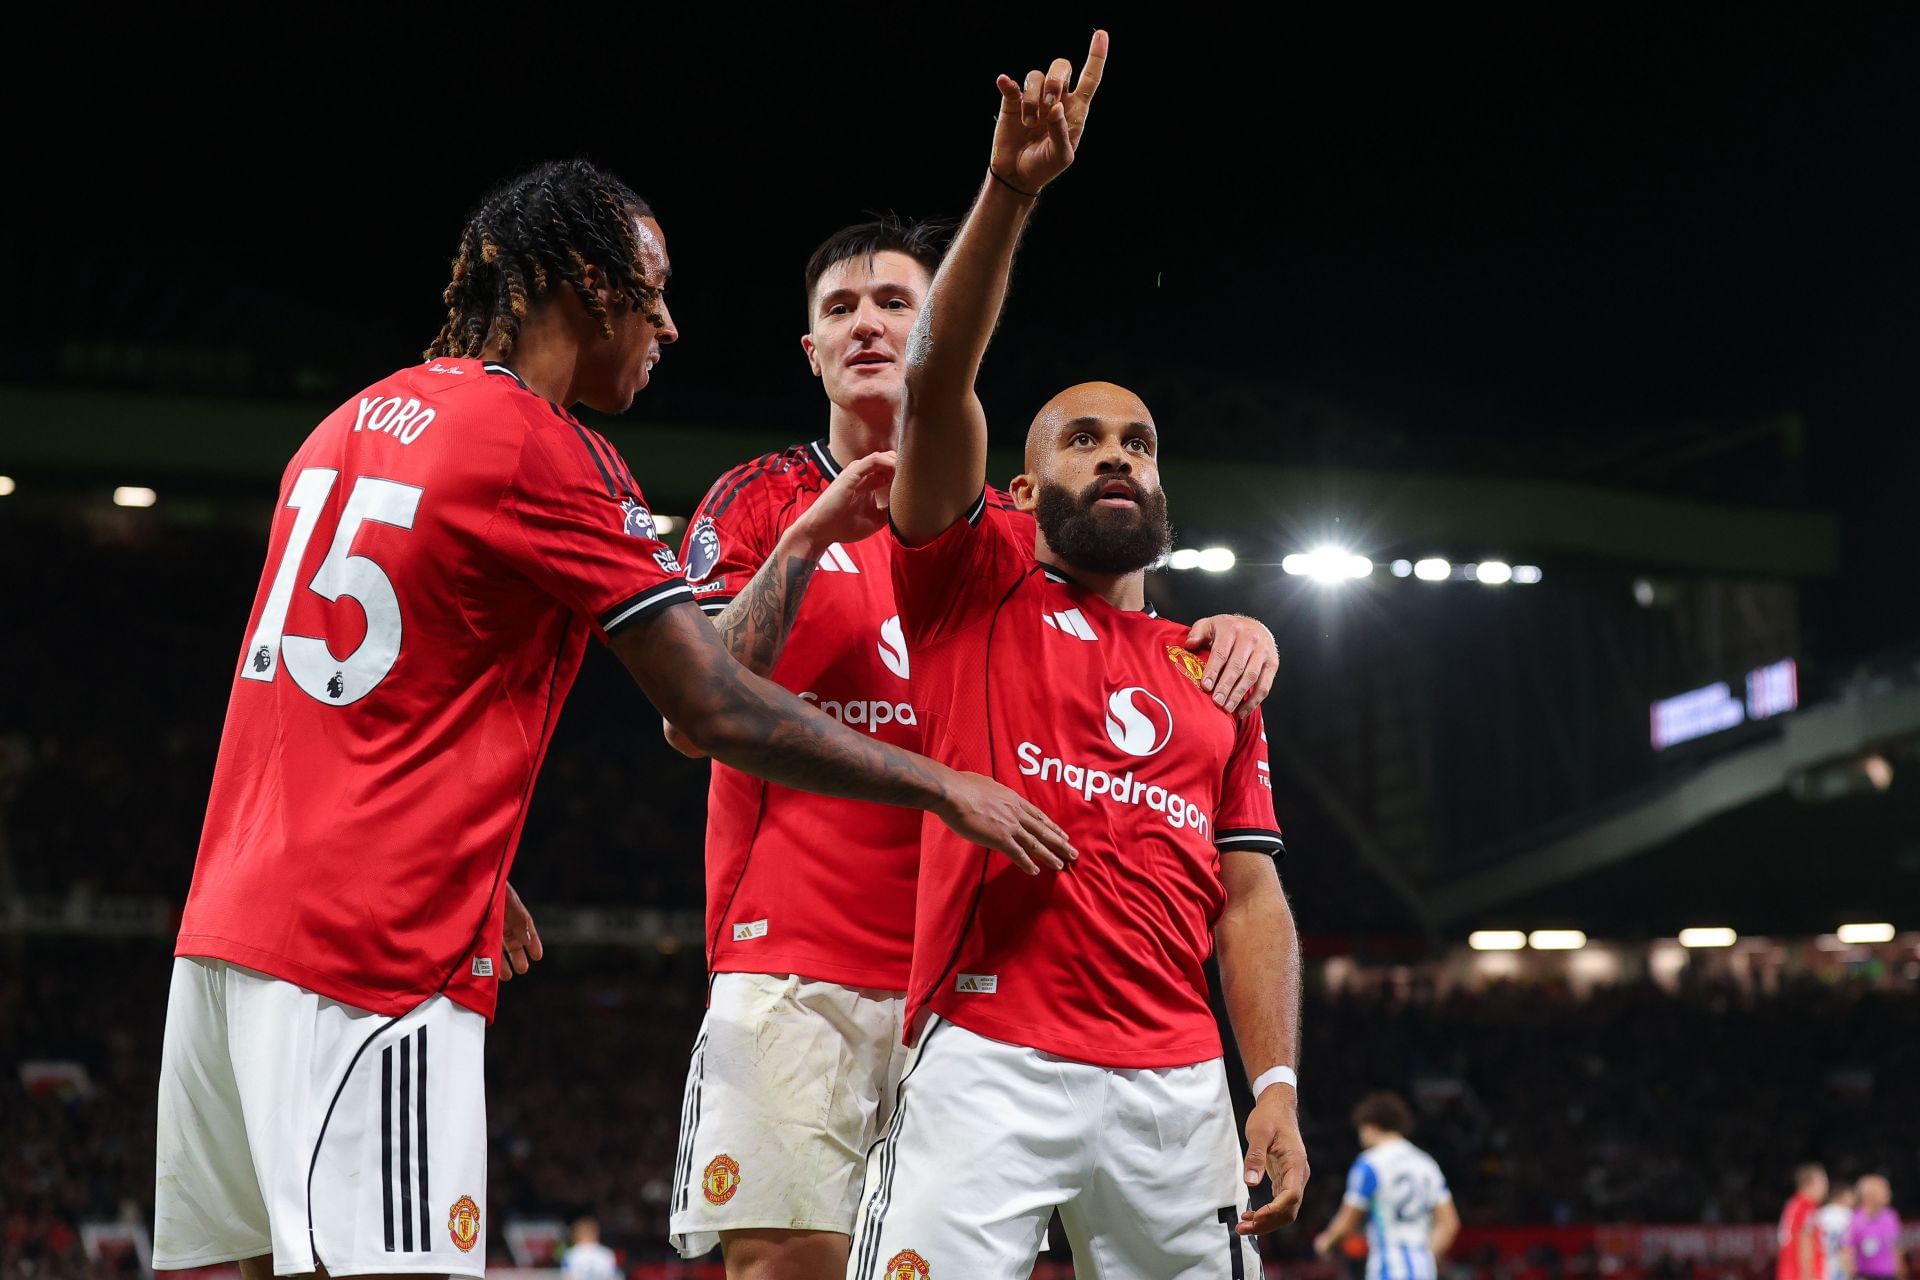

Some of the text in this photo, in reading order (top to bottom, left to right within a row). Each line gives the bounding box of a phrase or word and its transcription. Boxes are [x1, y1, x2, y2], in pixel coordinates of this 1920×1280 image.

[353, 396, 437, 445] YORO
[239, 466, 425, 707] 15
[798, 691, 918, 733] napa
[1017, 741, 1209, 841] Snapdragon
[889, 1252, 926, 1272] MANCHESTER
